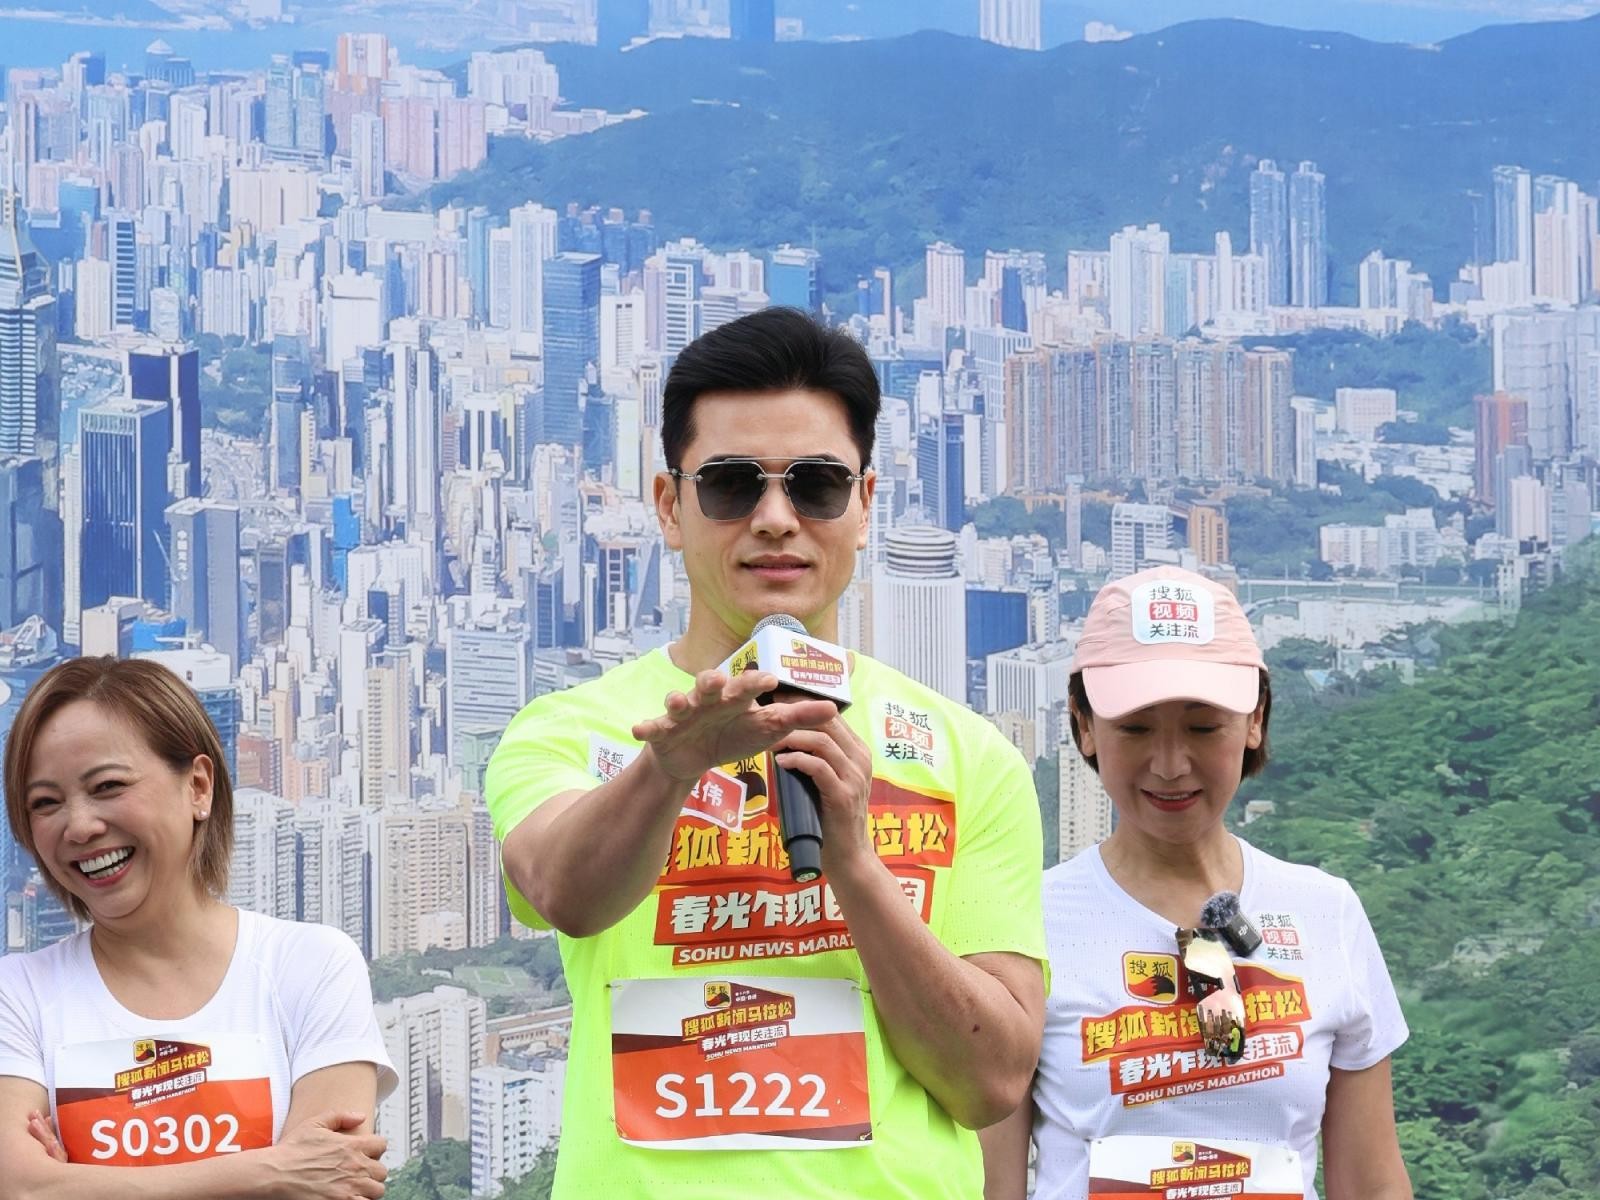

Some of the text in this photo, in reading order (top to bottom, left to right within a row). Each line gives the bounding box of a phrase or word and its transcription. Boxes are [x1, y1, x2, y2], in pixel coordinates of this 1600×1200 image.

[1150, 586, 1196, 602] 搜狐
[1152, 602, 1196, 620] 视频
[1150, 623, 1199, 638] 关注流
[885, 702, 932, 731] 搜狐
[885, 743, 934, 767] 关注流
[1259, 913, 1296, 928] 搜狐
[678, 943, 734, 963] SOHU
[740, 939, 794, 957] NEWS
[1267, 947, 1304, 960] 关注流
[1130, 960, 1173, 977] 搜狐
[684, 1001, 793, 1037] 搜狐新闻马拉松
[117, 1051, 209, 1088] 搜狐新闻马拉松
[655, 1072, 831, 1118] S1222
[1127, 1066, 1280, 1104] SOHU NEWS MARATHON
[91, 1114, 242, 1160] S0302
[1152, 1161, 1249, 1186] 搜狐新闻马拉松
